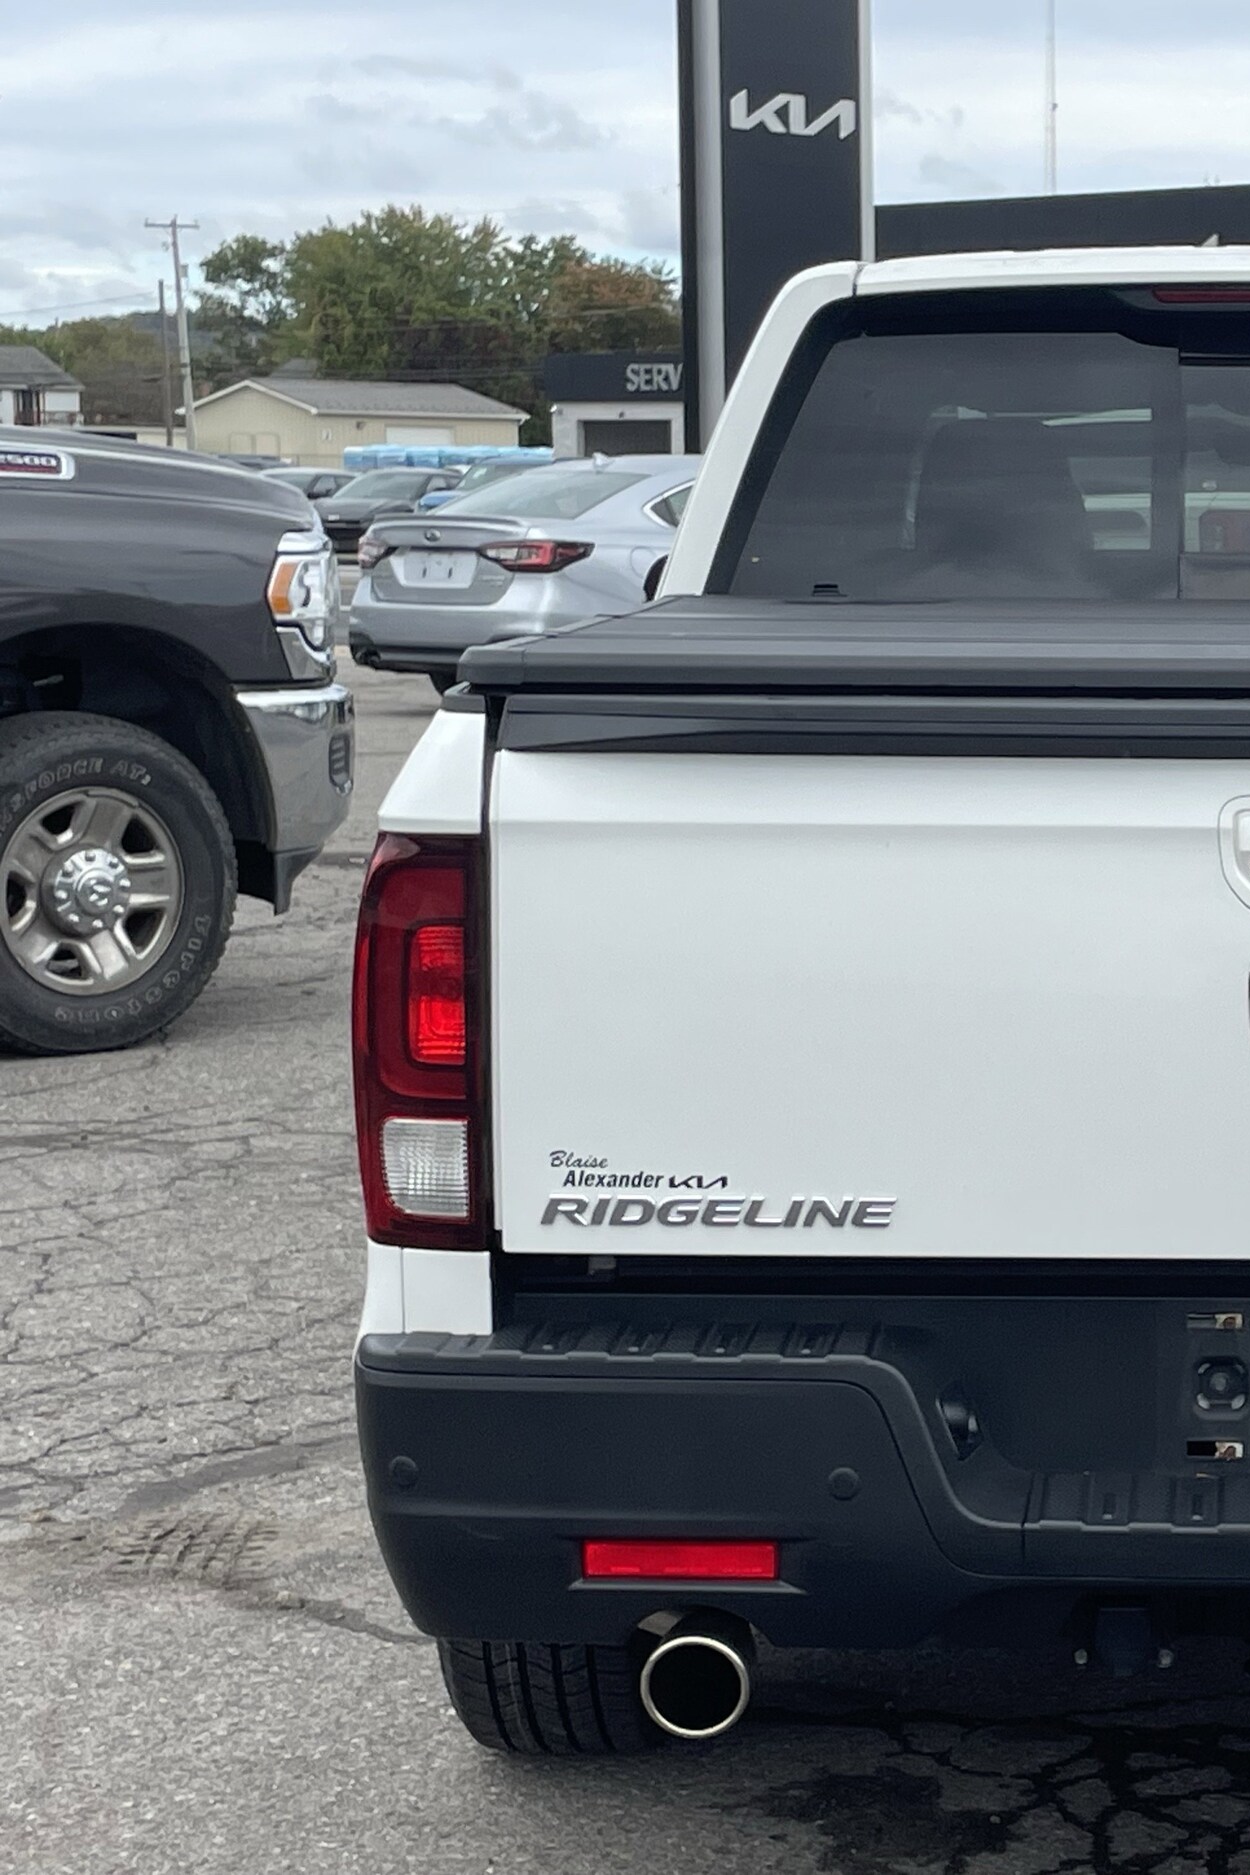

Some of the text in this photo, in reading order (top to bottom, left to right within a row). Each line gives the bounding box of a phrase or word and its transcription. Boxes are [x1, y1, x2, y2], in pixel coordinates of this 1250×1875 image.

[730, 88, 856, 140] KIA
[626, 362, 684, 392] SERV
[550, 1150, 609, 1169] Blaise
[562, 1170, 729, 1189] Alexander KIA
[540, 1193, 898, 1228] RIDGELINE
